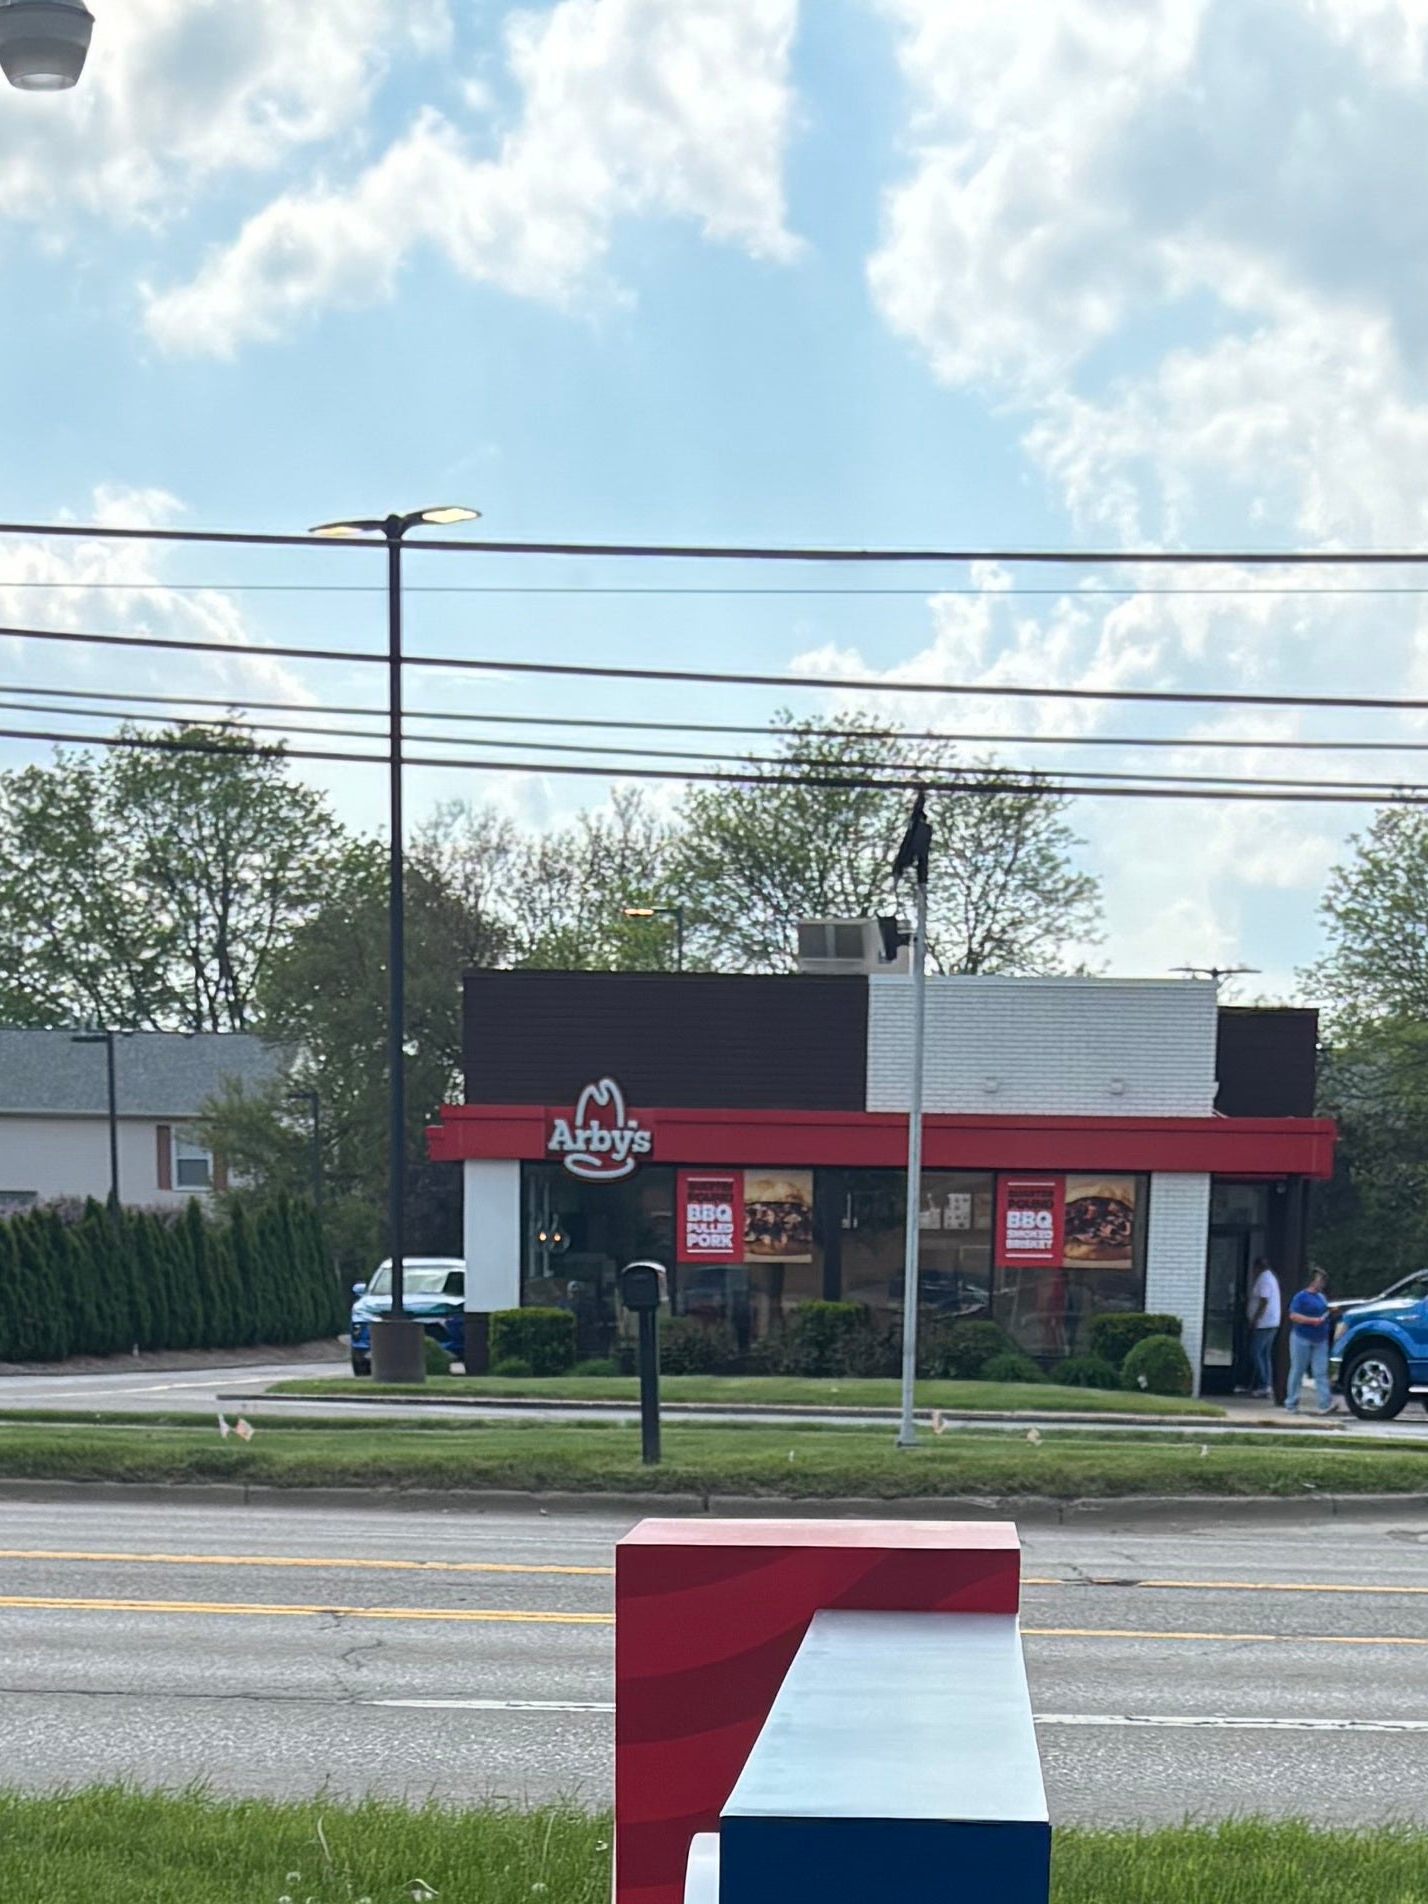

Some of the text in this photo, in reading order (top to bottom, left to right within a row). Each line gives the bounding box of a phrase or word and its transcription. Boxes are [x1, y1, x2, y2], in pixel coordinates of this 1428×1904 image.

[548, 1119, 652, 1161] Arby's
[687, 1204, 733, 1222] BBQ
[1006, 1211, 1053, 1229] BBQ
[687, 1222, 734, 1233] PULLED
[687, 1233, 733, 1248] PORK
